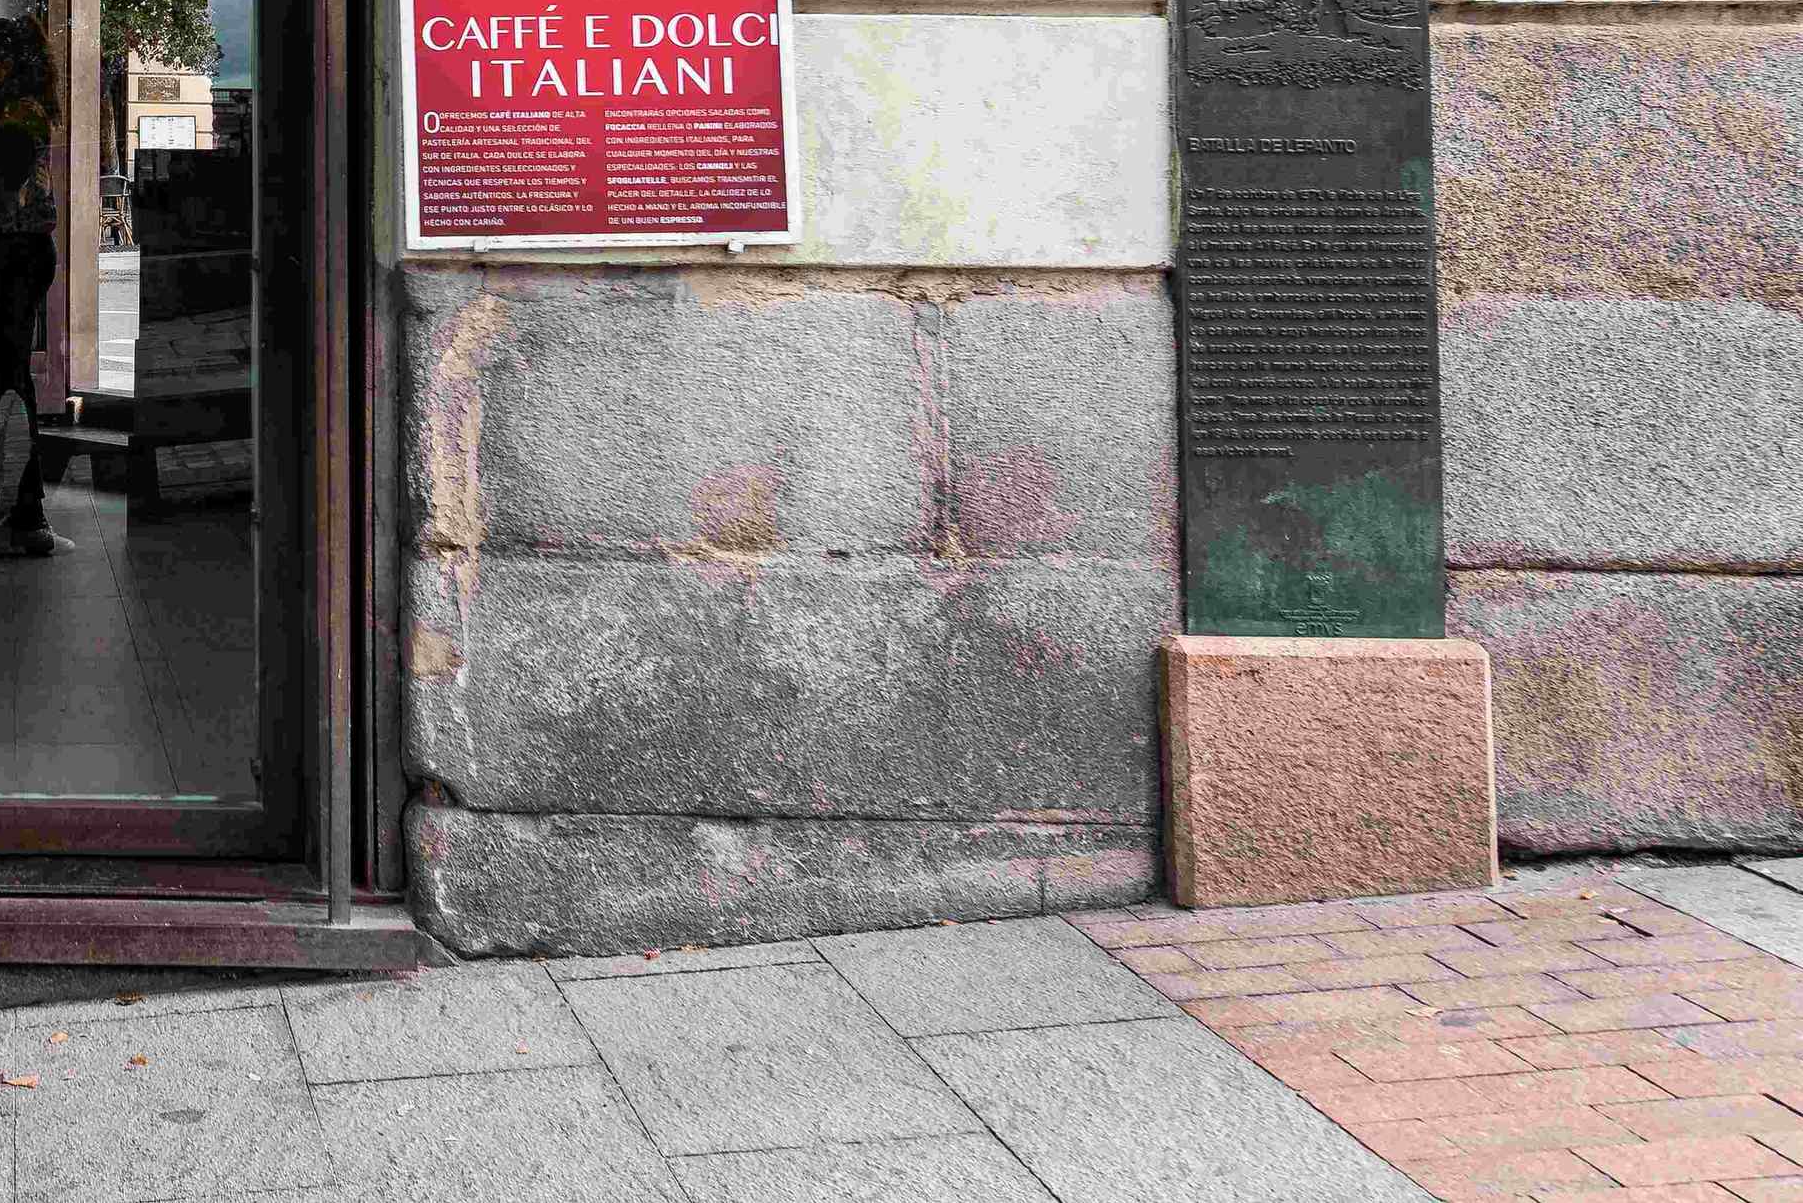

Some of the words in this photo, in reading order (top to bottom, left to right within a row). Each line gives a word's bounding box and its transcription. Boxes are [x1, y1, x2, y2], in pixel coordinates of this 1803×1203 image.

[421, 5, 565, 52] CAFFÉ
[584, 15, 612, 49] E
[632, 12, 779, 48] DOLCI
[470, 56, 734, 98] ITALIANI
[1187, 137, 1255, 154] BATALLA
[1258, 138, 1283, 154] DE
[1284, 138, 1357, 155] LEPANTO
